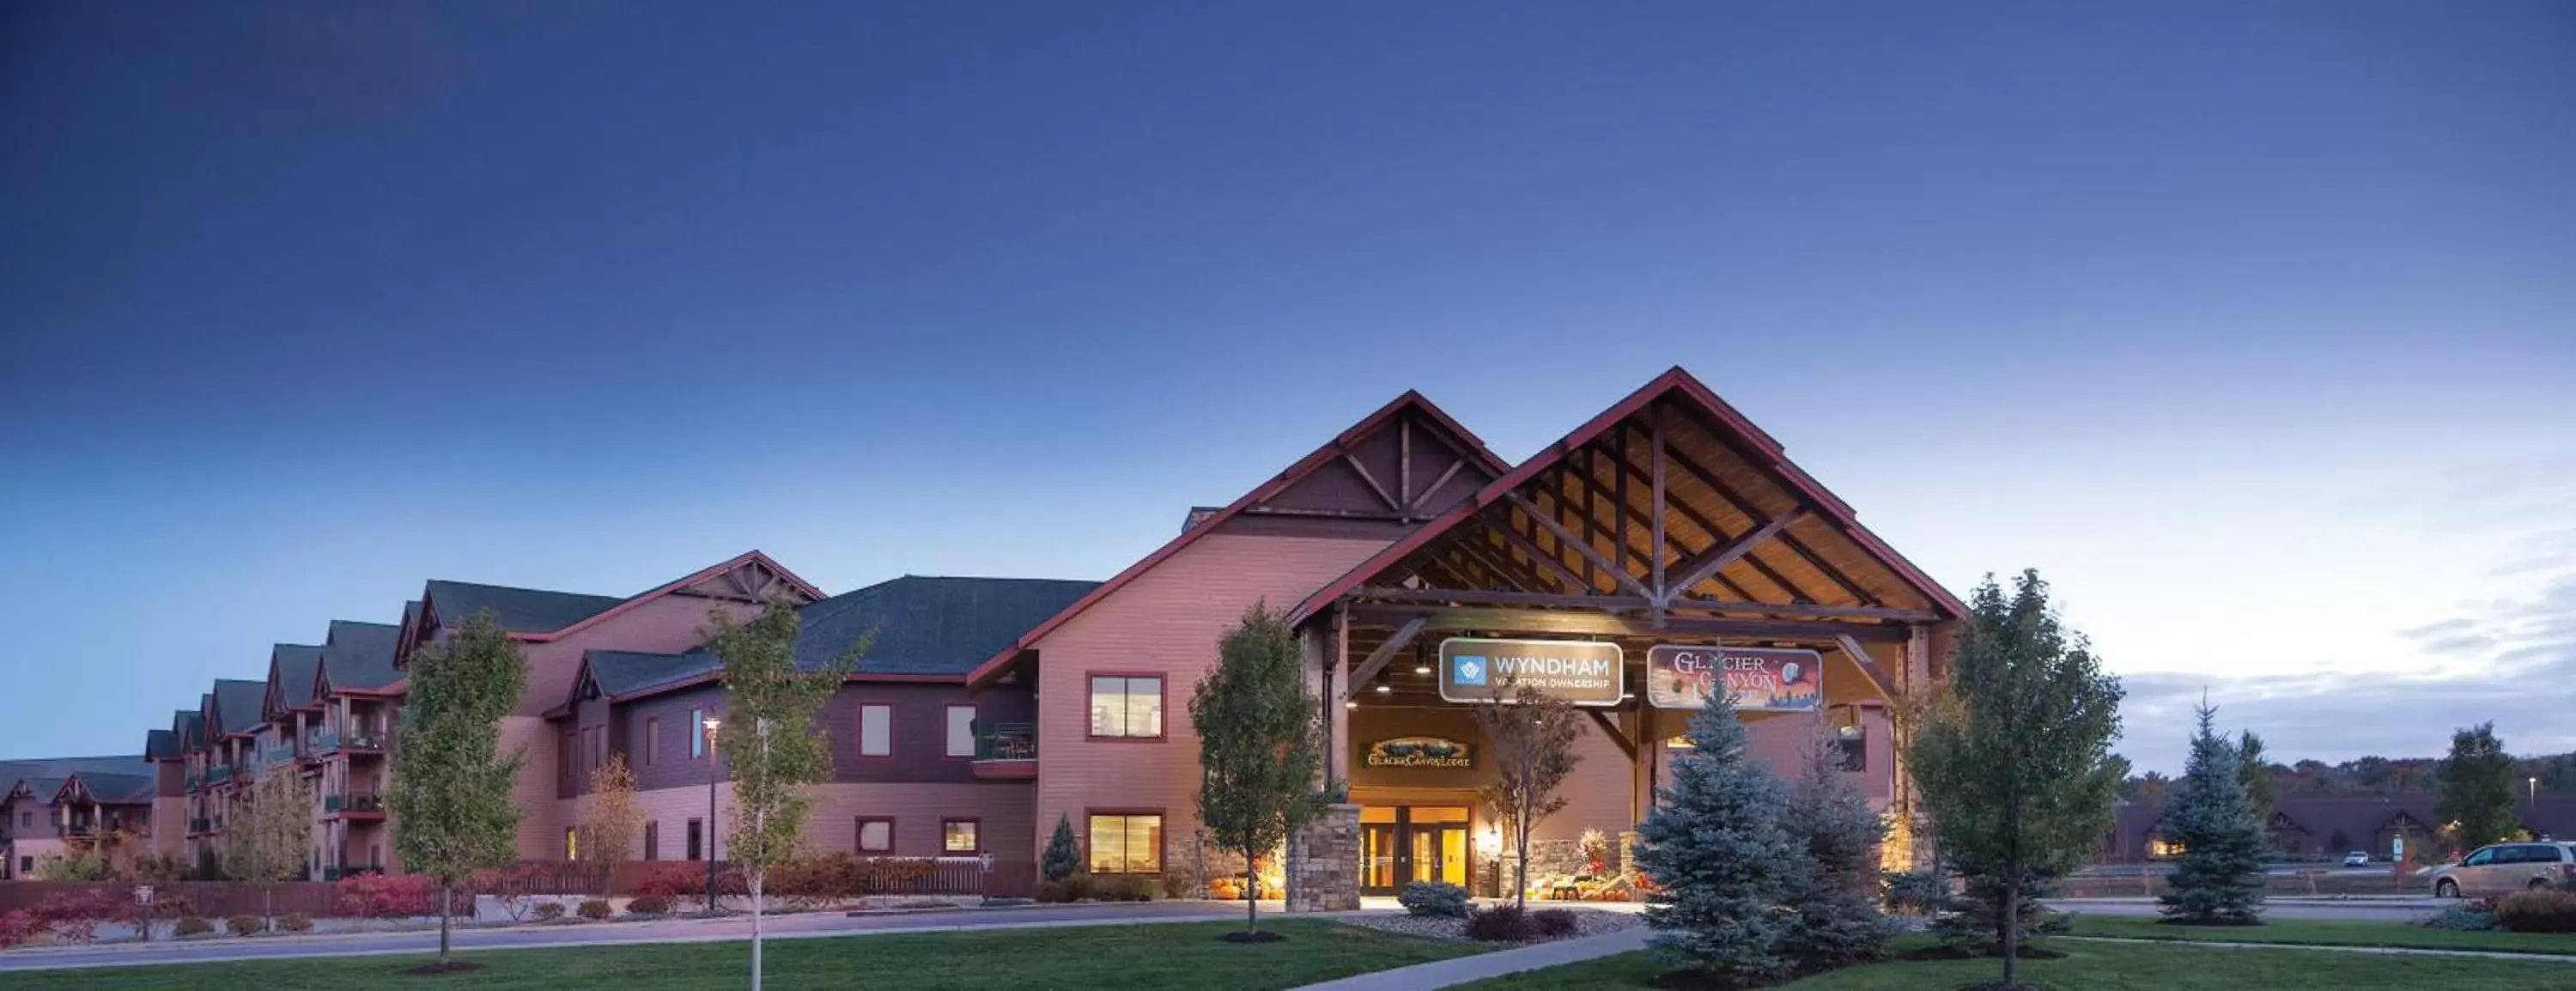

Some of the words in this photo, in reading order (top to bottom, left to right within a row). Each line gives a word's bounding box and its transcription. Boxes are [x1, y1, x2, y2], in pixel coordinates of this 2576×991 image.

[1495, 657, 1608, 676] WYNDHAM
[1548, 678, 1609, 688] OWNERSHIP
[1699, 672, 1777, 692] CNYON
